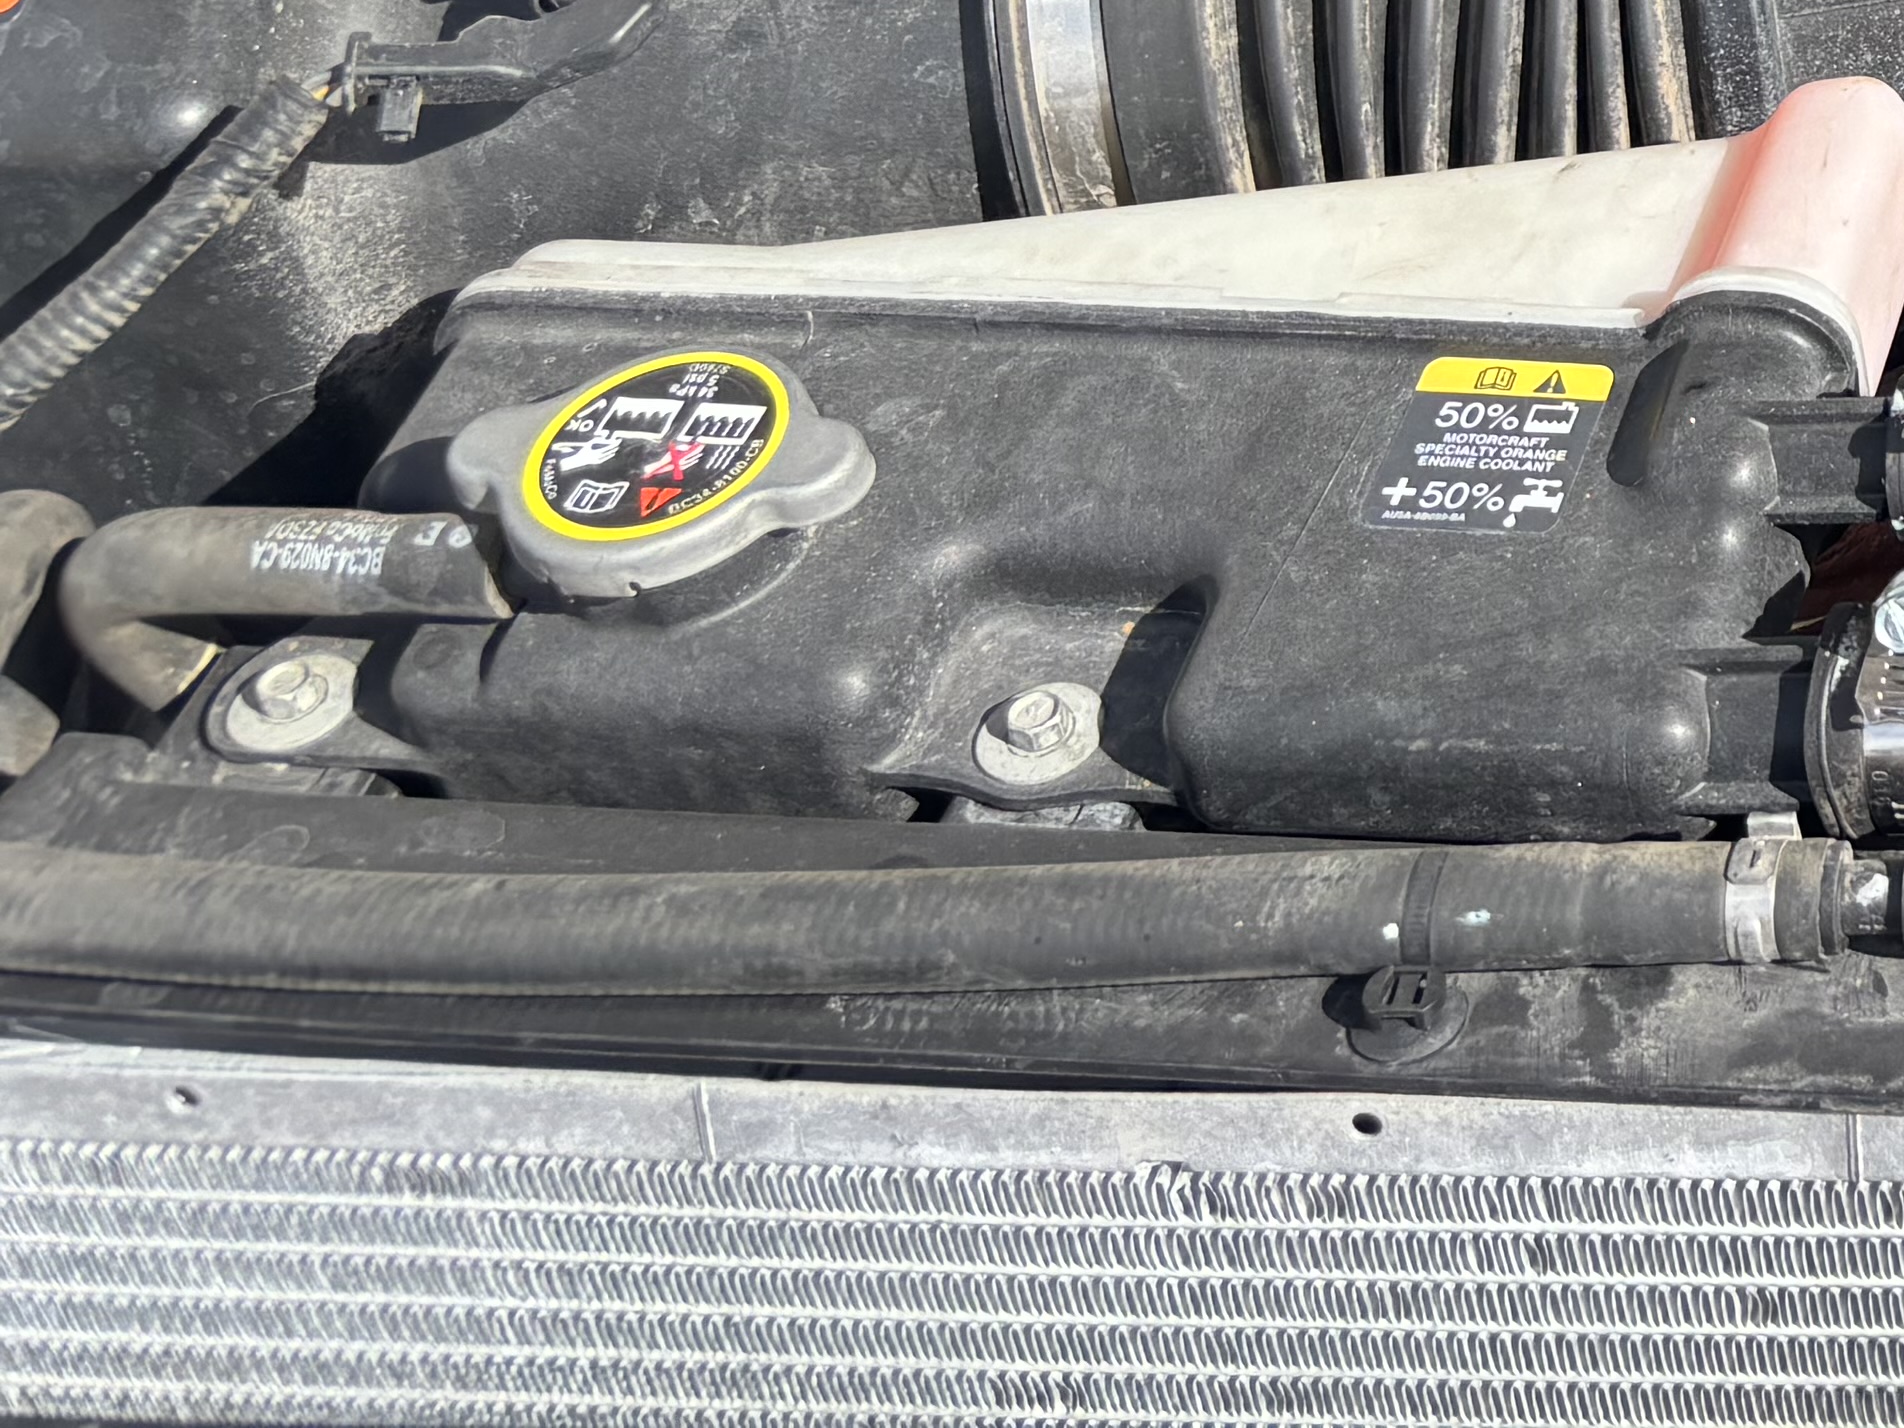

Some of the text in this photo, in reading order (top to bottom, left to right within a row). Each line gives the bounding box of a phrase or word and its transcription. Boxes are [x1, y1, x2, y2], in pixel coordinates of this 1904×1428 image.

[566, 418, 595, 433] OK
[1434, 400, 1520, 432] 50%
[1442, 432, 1550, 449] MOTORCRAFT
[1414, 443, 1568, 462] SPECIALTY ORANGE
[1417, 455, 1556, 474] ENGINE COOLANT
